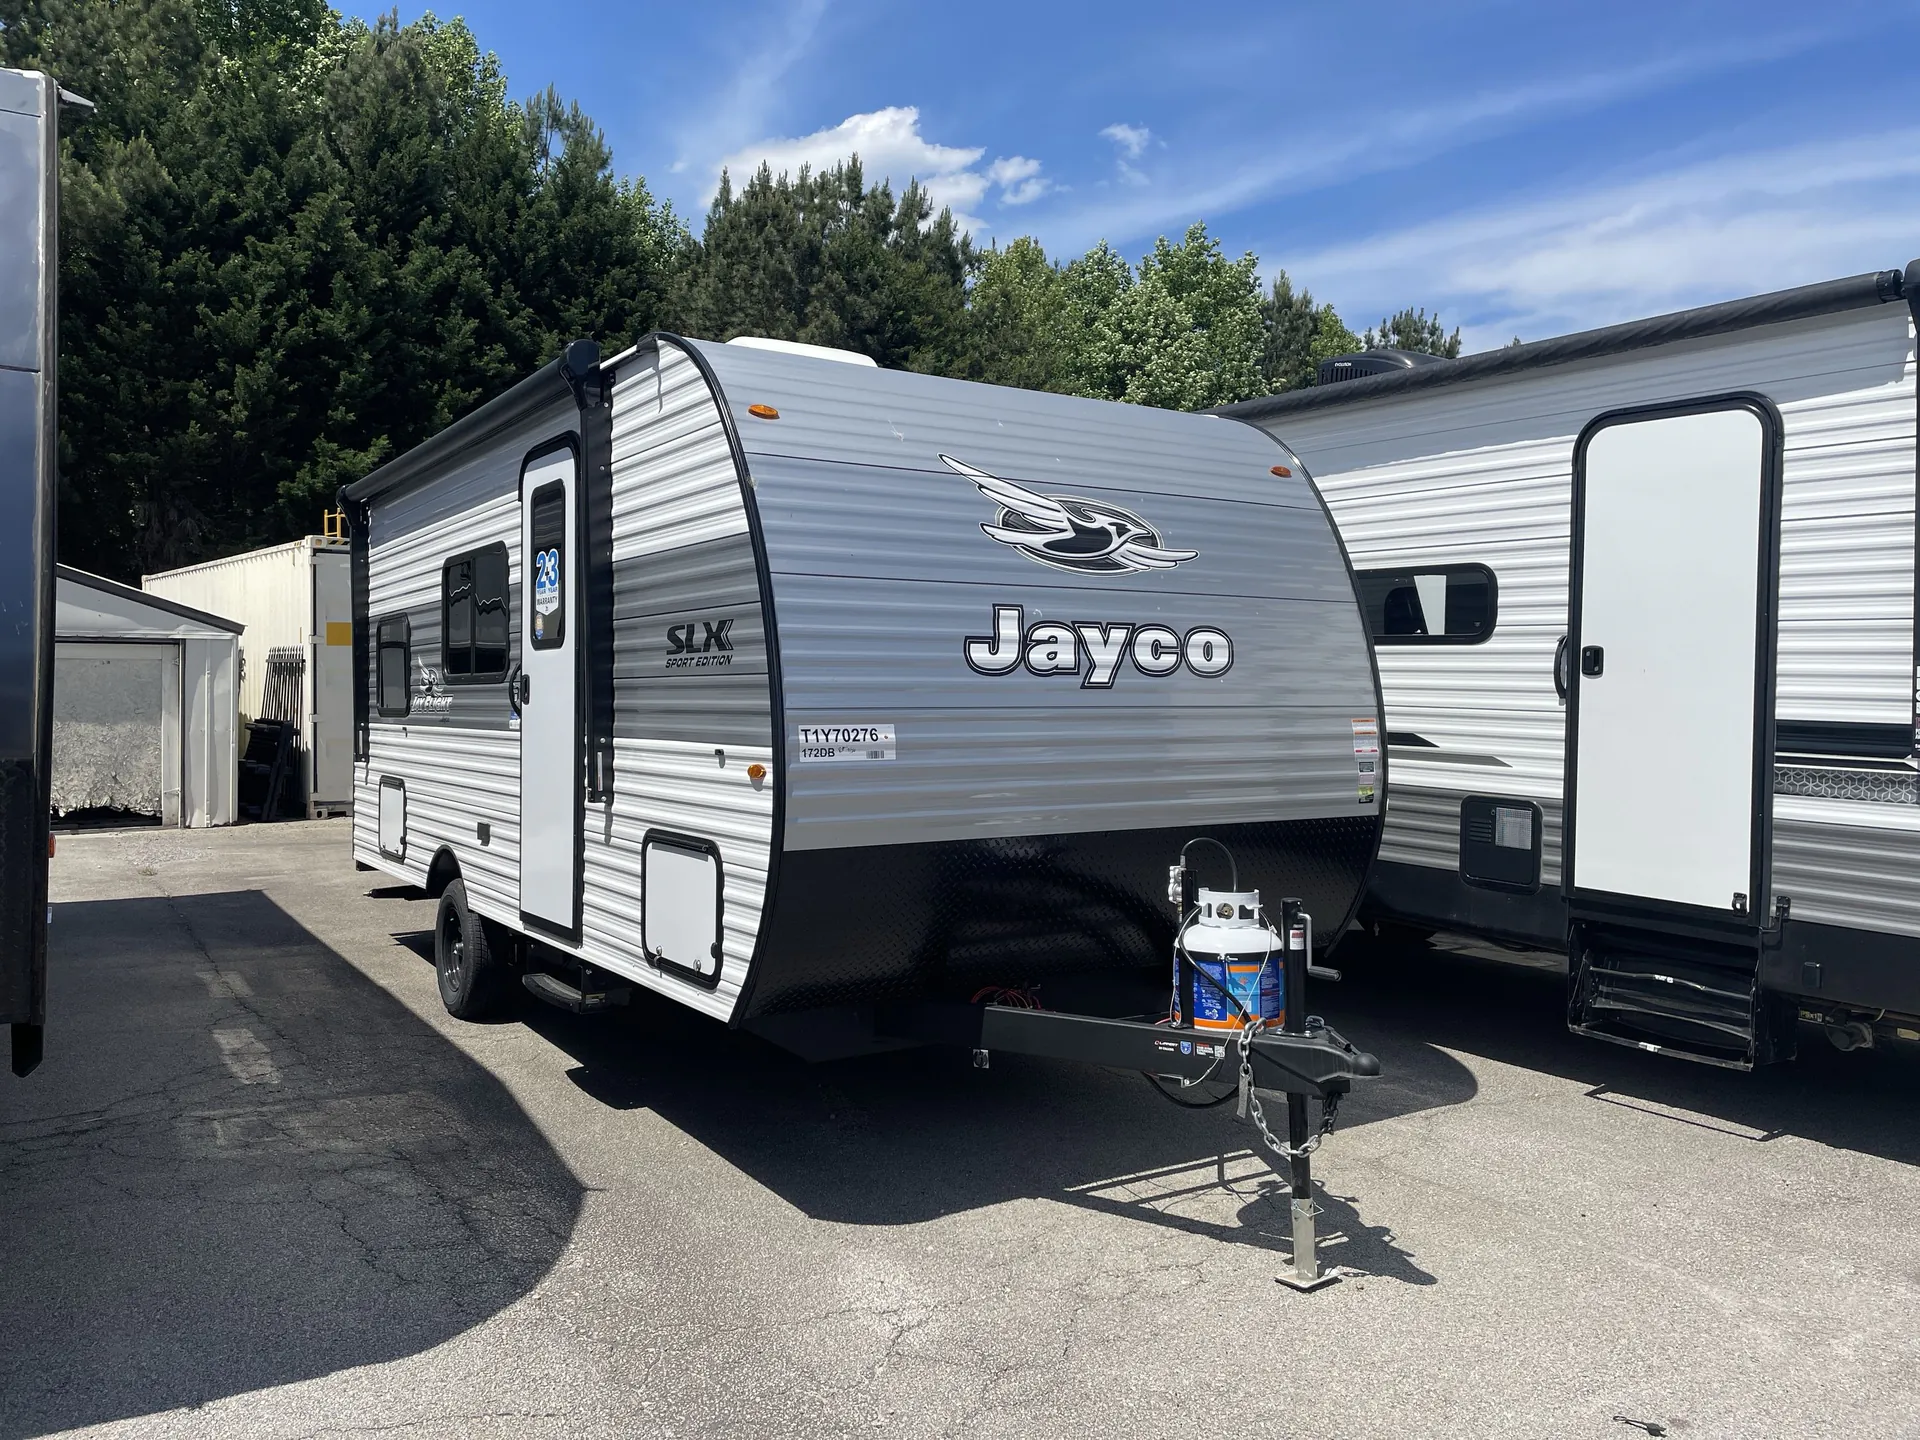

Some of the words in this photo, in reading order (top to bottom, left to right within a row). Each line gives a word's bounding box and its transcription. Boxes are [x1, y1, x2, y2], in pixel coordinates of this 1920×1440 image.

[666, 618, 735, 656] SLX
[963, 603, 1234, 690] Jayco
[665, 657, 695, 669] SPORT
[695, 654, 733, 667] EDITION
[800, 727, 879, 743] T1Y70276
[801, 747, 836, 758] 172DB
